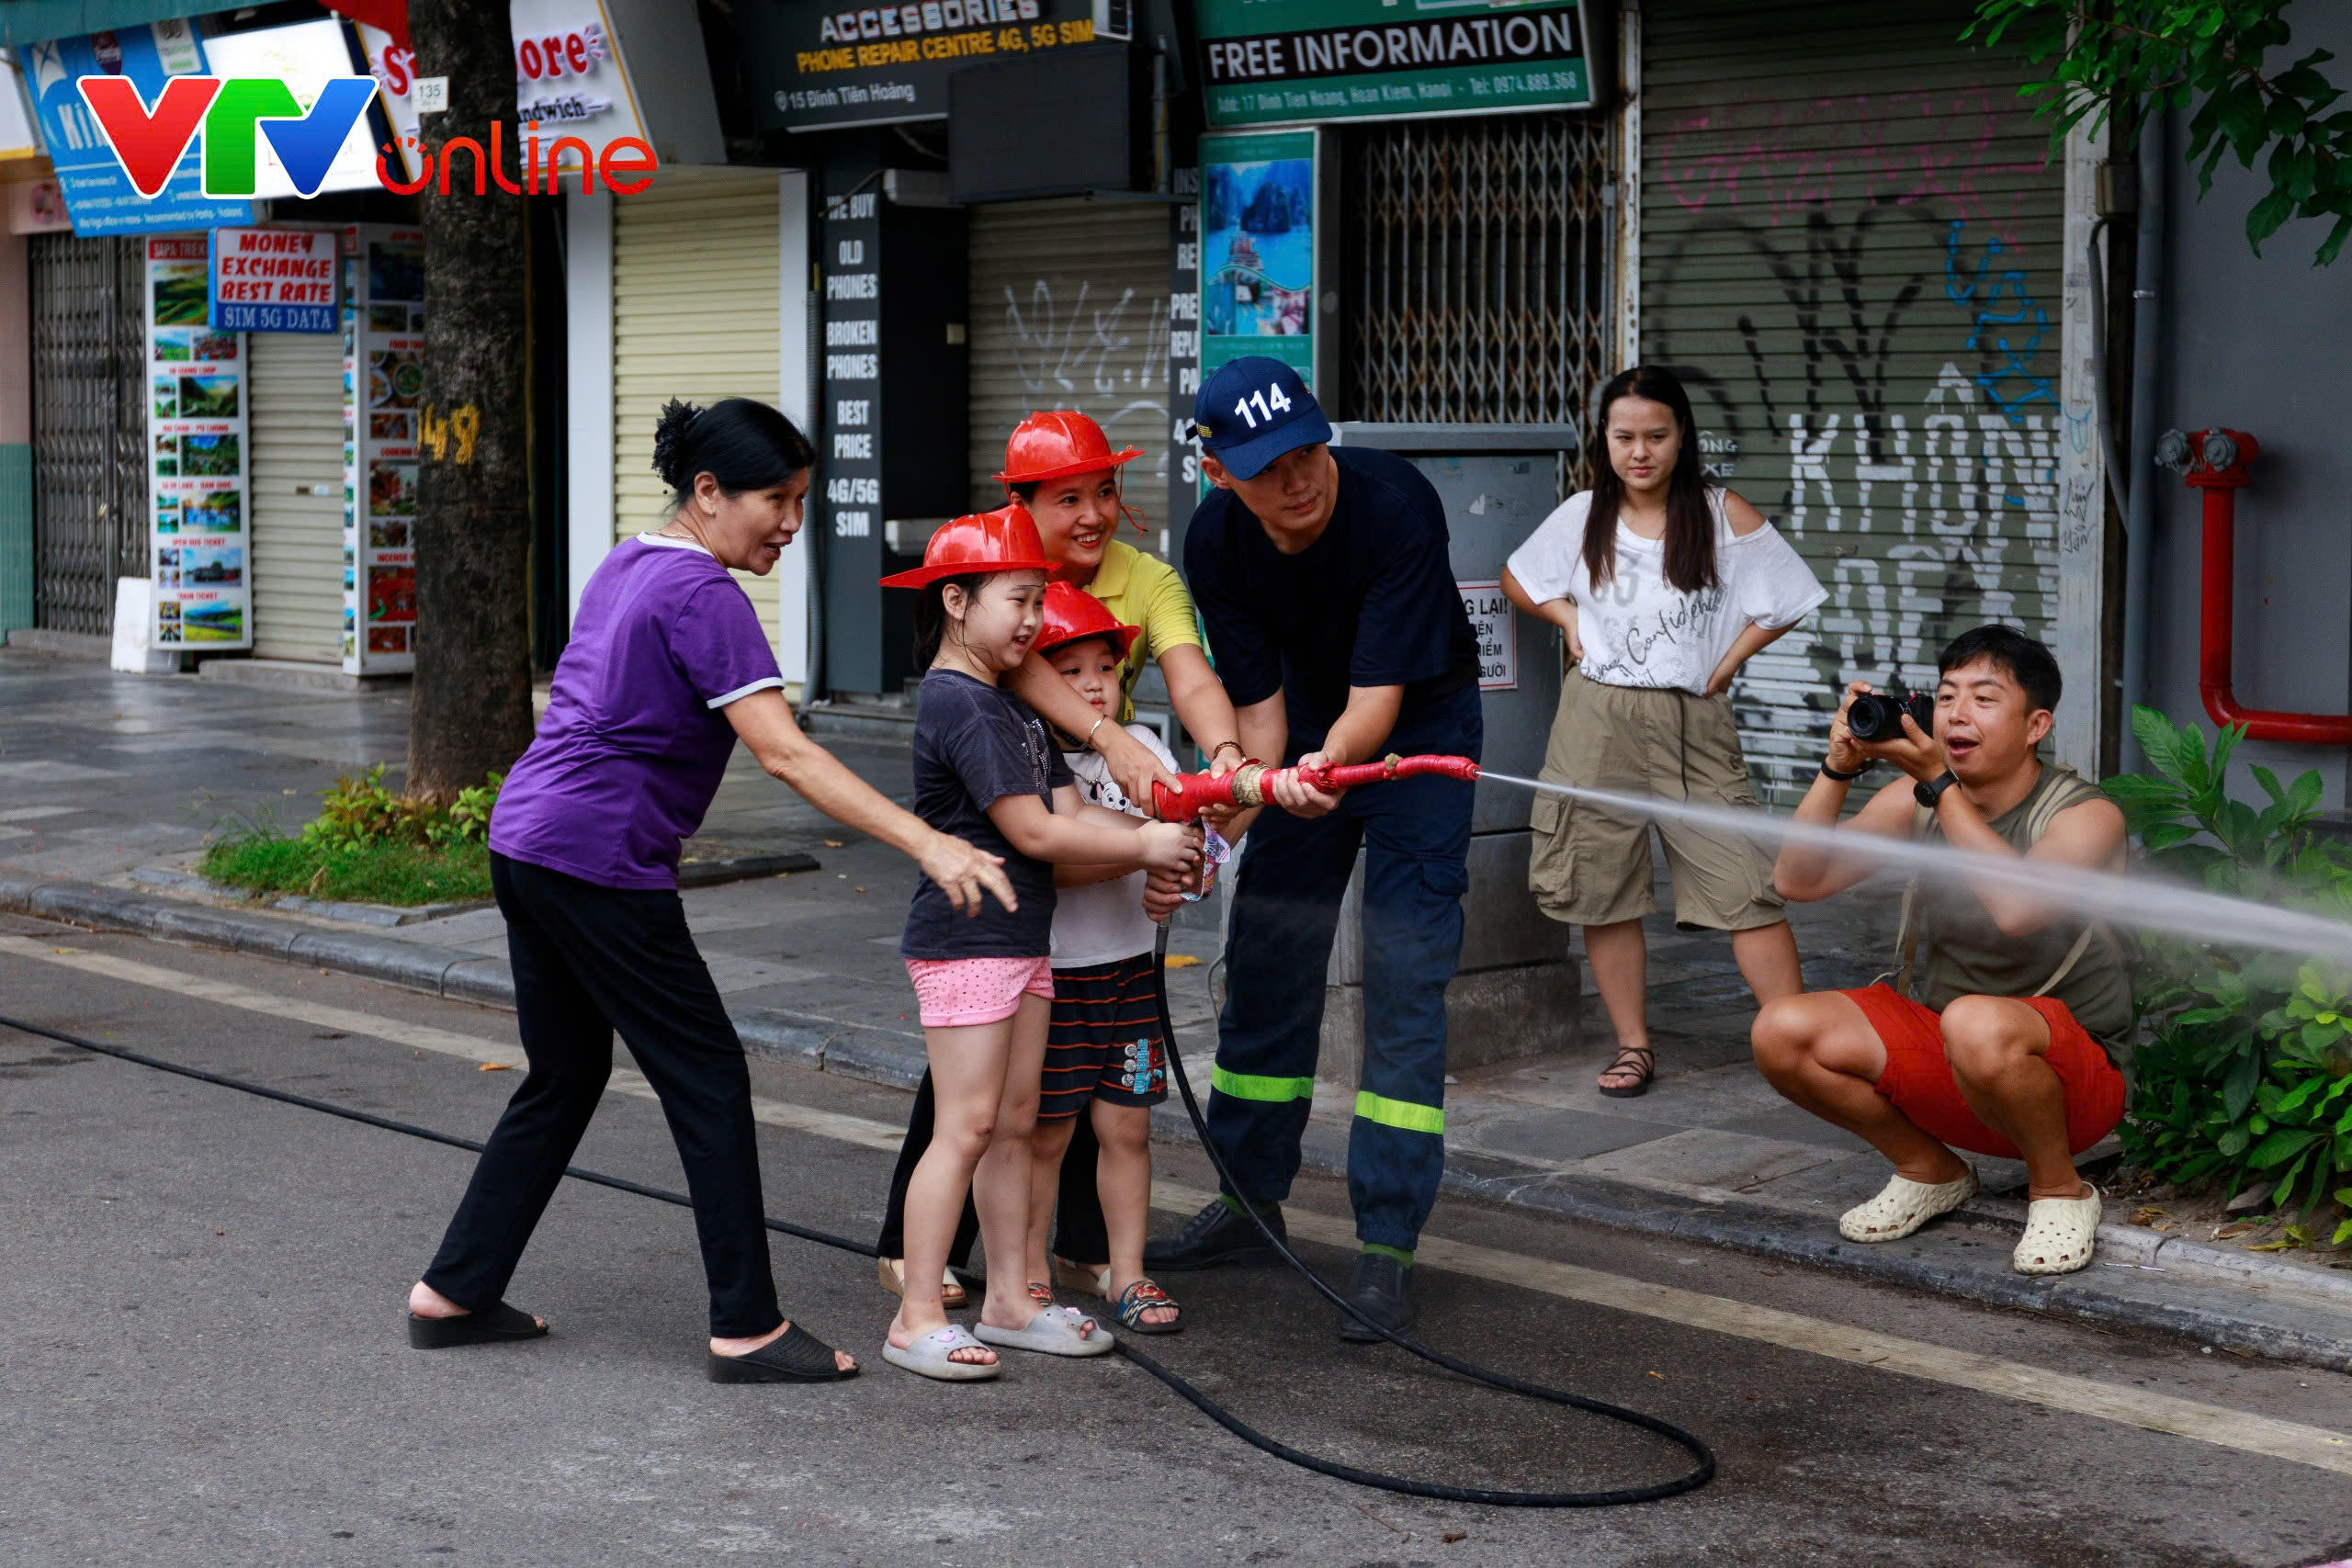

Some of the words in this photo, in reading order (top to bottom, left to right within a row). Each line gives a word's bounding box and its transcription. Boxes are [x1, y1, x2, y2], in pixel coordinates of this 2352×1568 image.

[820, 0, 1039, 43] ACCESSORIES
[797, 47, 855, 73] PHONE
[857, 39, 921, 66] REPAIR
[922, 31, 995, 60] CENTRE
[997, 27, 1029, 53] 4G,
[1030, 24, 1057, 47] 5G
[1059, 18, 1095, 44] SIM
[1208, 39, 1286, 79] FREE
[1294, 13, 1573, 73] INFORMATION
[419, 84, 441, 97] 135
[789, 91, 806, 109] 15
[1242, 95, 1257, 110] 17
[850, 193, 876, 219] BUY
[239, 233, 315, 254] MONEY
[839, 240, 865, 265] OLD
[221, 256, 332, 279] EXCHANGE
[278, 282, 332, 303] RATE
[827, 274, 877, 299] PHONES
[224, 306, 256, 328] SIM
[260, 306, 282, 328] 5G
[287, 308, 333, 330] DATA
[827, 320, 877, 346] BROKEN
[827, 354, 878, 379] PHONES
[837, 400, 870, 425] BEST
[1234, 382, 1292, 429] 114
[834, 434, 872, 459] PRICE
[1789, 362, 2061, 544] KHÔN
[827, 478, 879, 504] 4G/5G
[836, 512, 870, 536] SIM
[1480, 597, 1508, 618] LẠI!
[1473, 620, 1493, 638] ỆN
